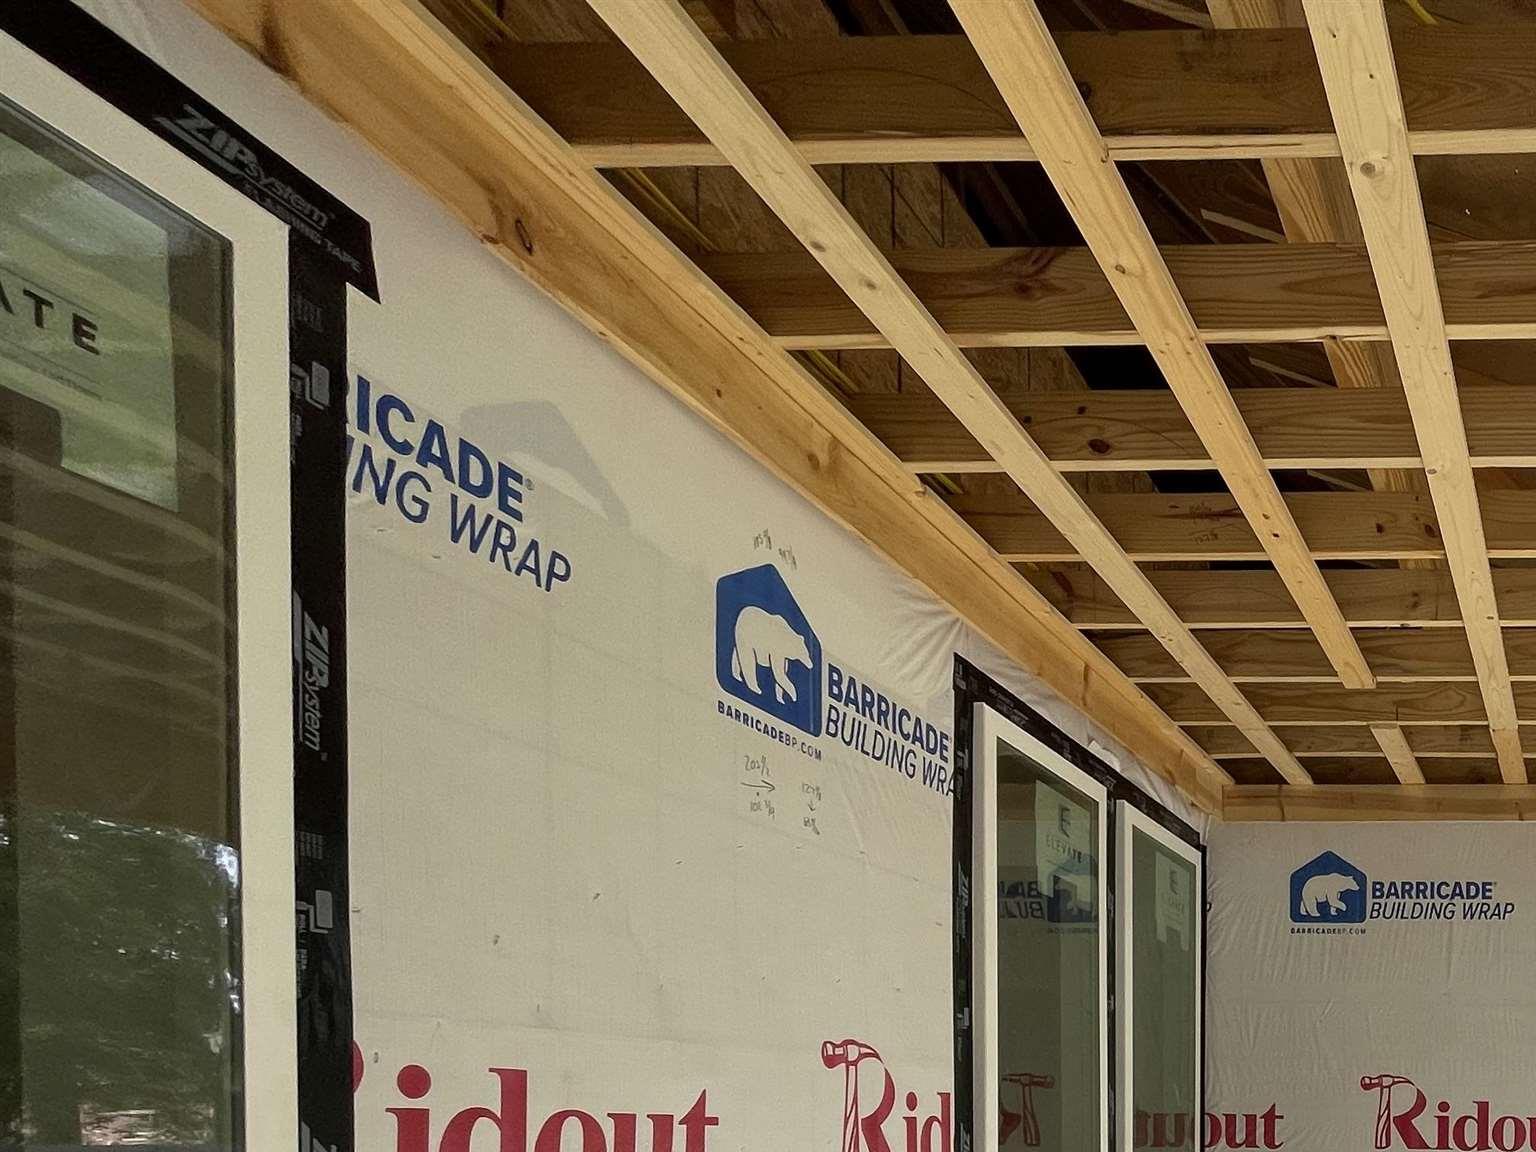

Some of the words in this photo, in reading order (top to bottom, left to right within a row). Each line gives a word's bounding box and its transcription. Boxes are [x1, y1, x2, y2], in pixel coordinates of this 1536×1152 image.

[356, 374, 523, 523] ICADE
[450, 492, 571, 592] WRAP
[717, 700, 823, 761] BARRICADEBP.COM
[825, 703, 917, 780] BUILDING
[921, 755, 957, 798] WRA
[828, 662, 949, 764] BARRICADE
[1369, 902, 1456, 921] BUILDING
[1462, 902, 1515, 921] WRAP
[1371, 880, 1493, 901] BARRICADE
